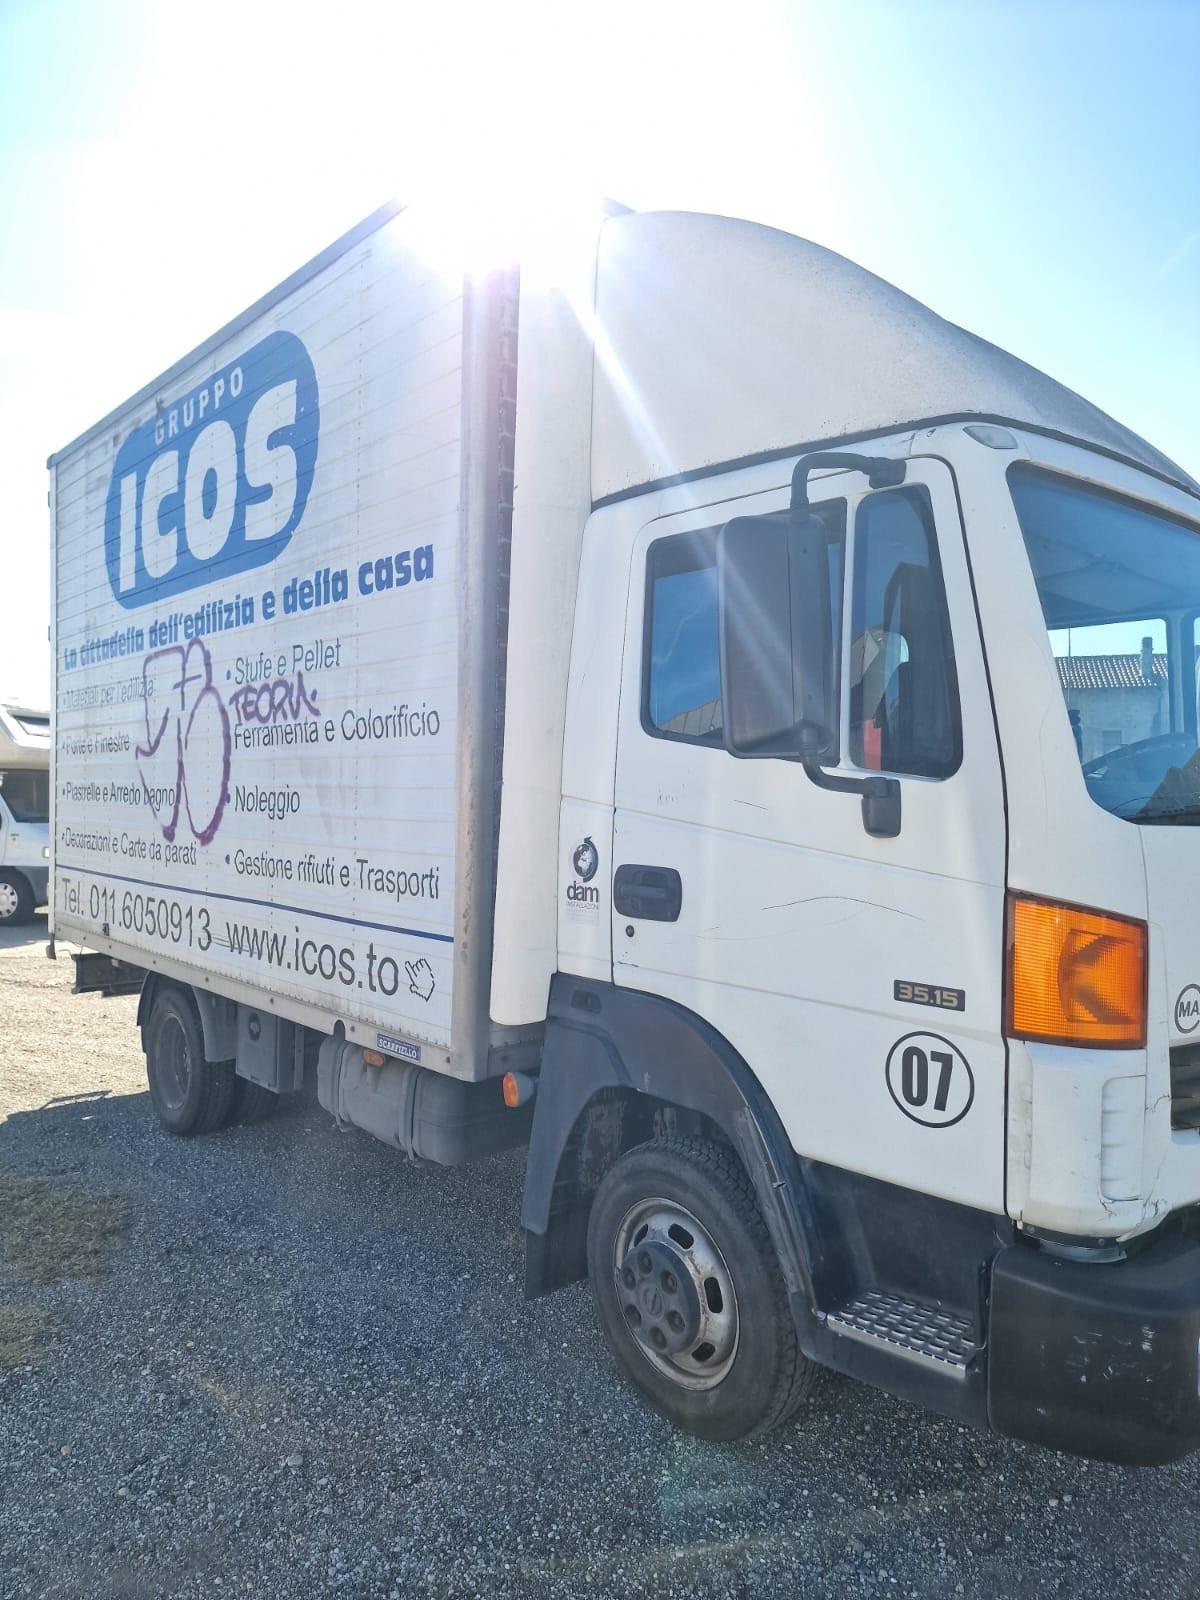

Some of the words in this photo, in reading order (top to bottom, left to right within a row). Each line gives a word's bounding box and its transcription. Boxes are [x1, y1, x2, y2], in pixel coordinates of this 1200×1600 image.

[155, 366, 243, 445] GRUPPO
[119, 380, 297, 593] ICOS
[80, 625, 145, 666] cittadella
[262, 590, 276, 620] e
[283, 568, 348, 615] della
[358, 544, 434, 595] casa
[235, 652, 272, 685] Stufe
[277, 654, 287, 676] e
[292, 638, 341, 673] Pellet
[101, 686, 115, 708] per
[96, 732, 130, 753] Finestre
[234, 716, 319, 750] Ferramenta
[324, 719, 335, 742] e
[341, 703, 440, 740] Colorificio
[66, 782, 101, 801] Piastrelle
[102, 788, 109, 801] e
[110, 782, 140, 806] Arredo
[143, 784, 175, 811] bagno
[235, 784, 300, 820] Noleggio
[65, 827, 112, 852] Decorazioni
[112, 836, 118, 851] e
[121, 832, 146, 859] Carte
[150, 839, 162, 860] da
[165, 841, 197, 867] parati
[234, 849, 292, 880] Gestione
[298, 854, 335, 886] rifiuti
[339, 865, 350, 887] e
[356, 859, 439, 902] Trasporti
[567, 881, 599, 903] dam
[62, 878, 85, 915] Tel.
[90, 884, 212, 951] 011.6050913
[226, 922, 399, 996] www.icos.to
[898, 983, 959, 1008] 35.15
[901, 1046, 953, 1112] 07
